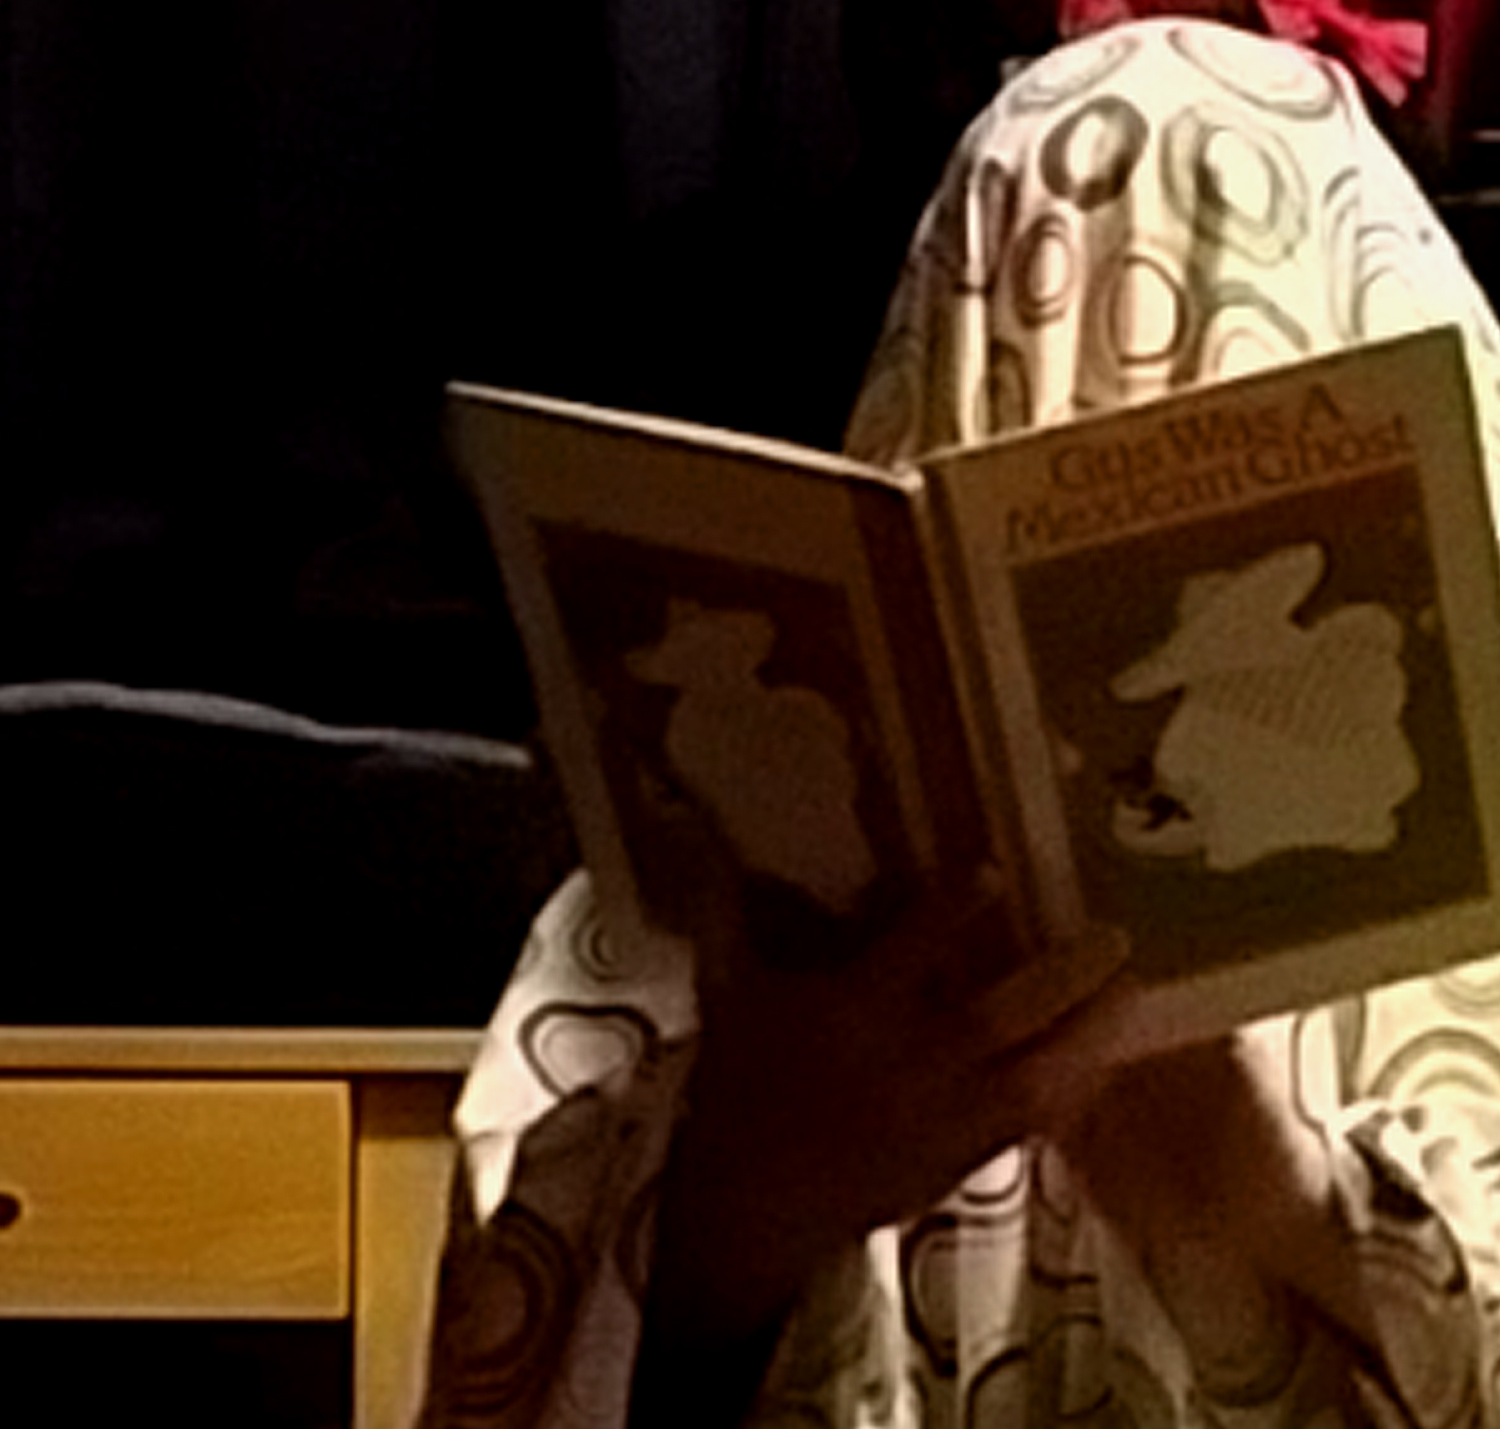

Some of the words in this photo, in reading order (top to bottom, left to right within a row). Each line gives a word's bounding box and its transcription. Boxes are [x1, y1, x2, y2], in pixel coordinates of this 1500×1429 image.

[1006, 465, 1244, 555] Mexican
[1247, 411, 1416, 486] Ghost
[1050, 434, 1162, 492] Gus
[1163, 405, 1282, 462] Was
[1300, 383, 1344, 432] A
